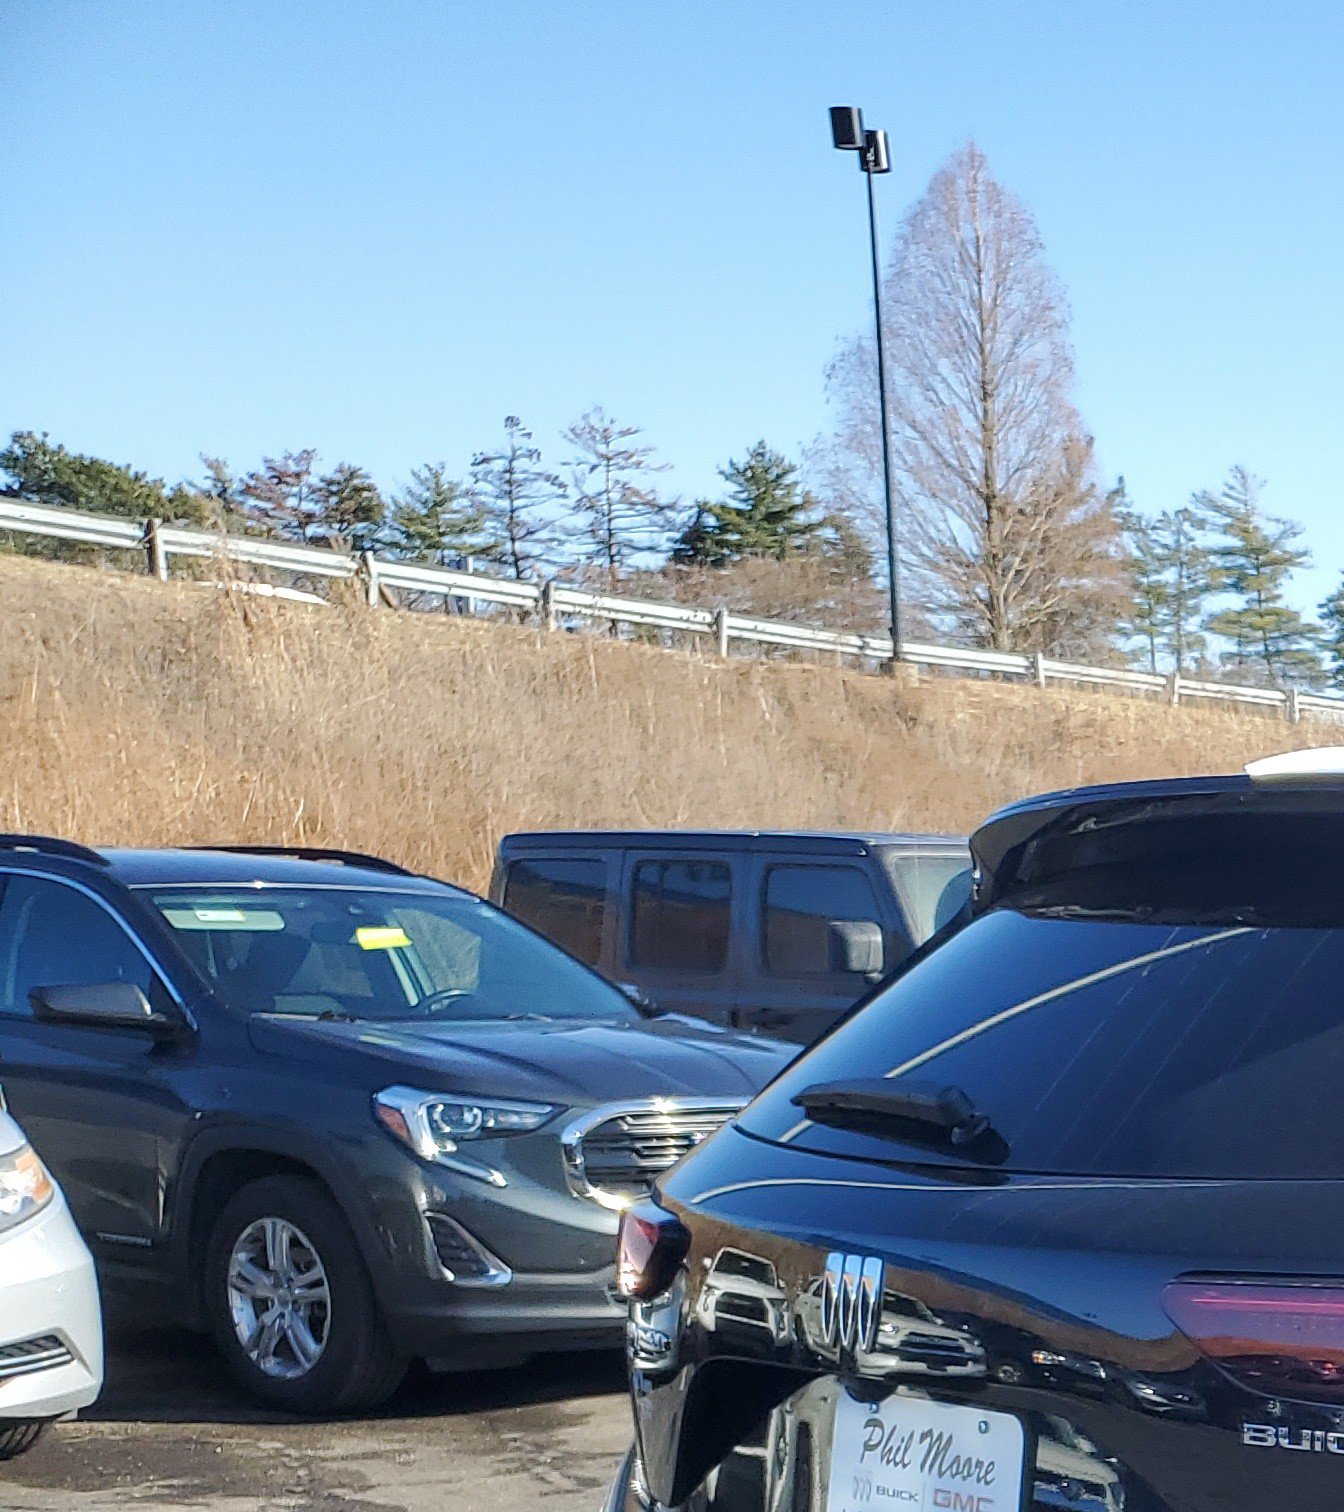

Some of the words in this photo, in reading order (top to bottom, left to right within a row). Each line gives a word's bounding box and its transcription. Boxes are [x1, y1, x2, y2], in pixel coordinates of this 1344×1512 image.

[860, 1417, 915, 1469] Phil
[919, 1428, 995, 1486] Moore
[876, 1485, 919, 1503] BUICK
